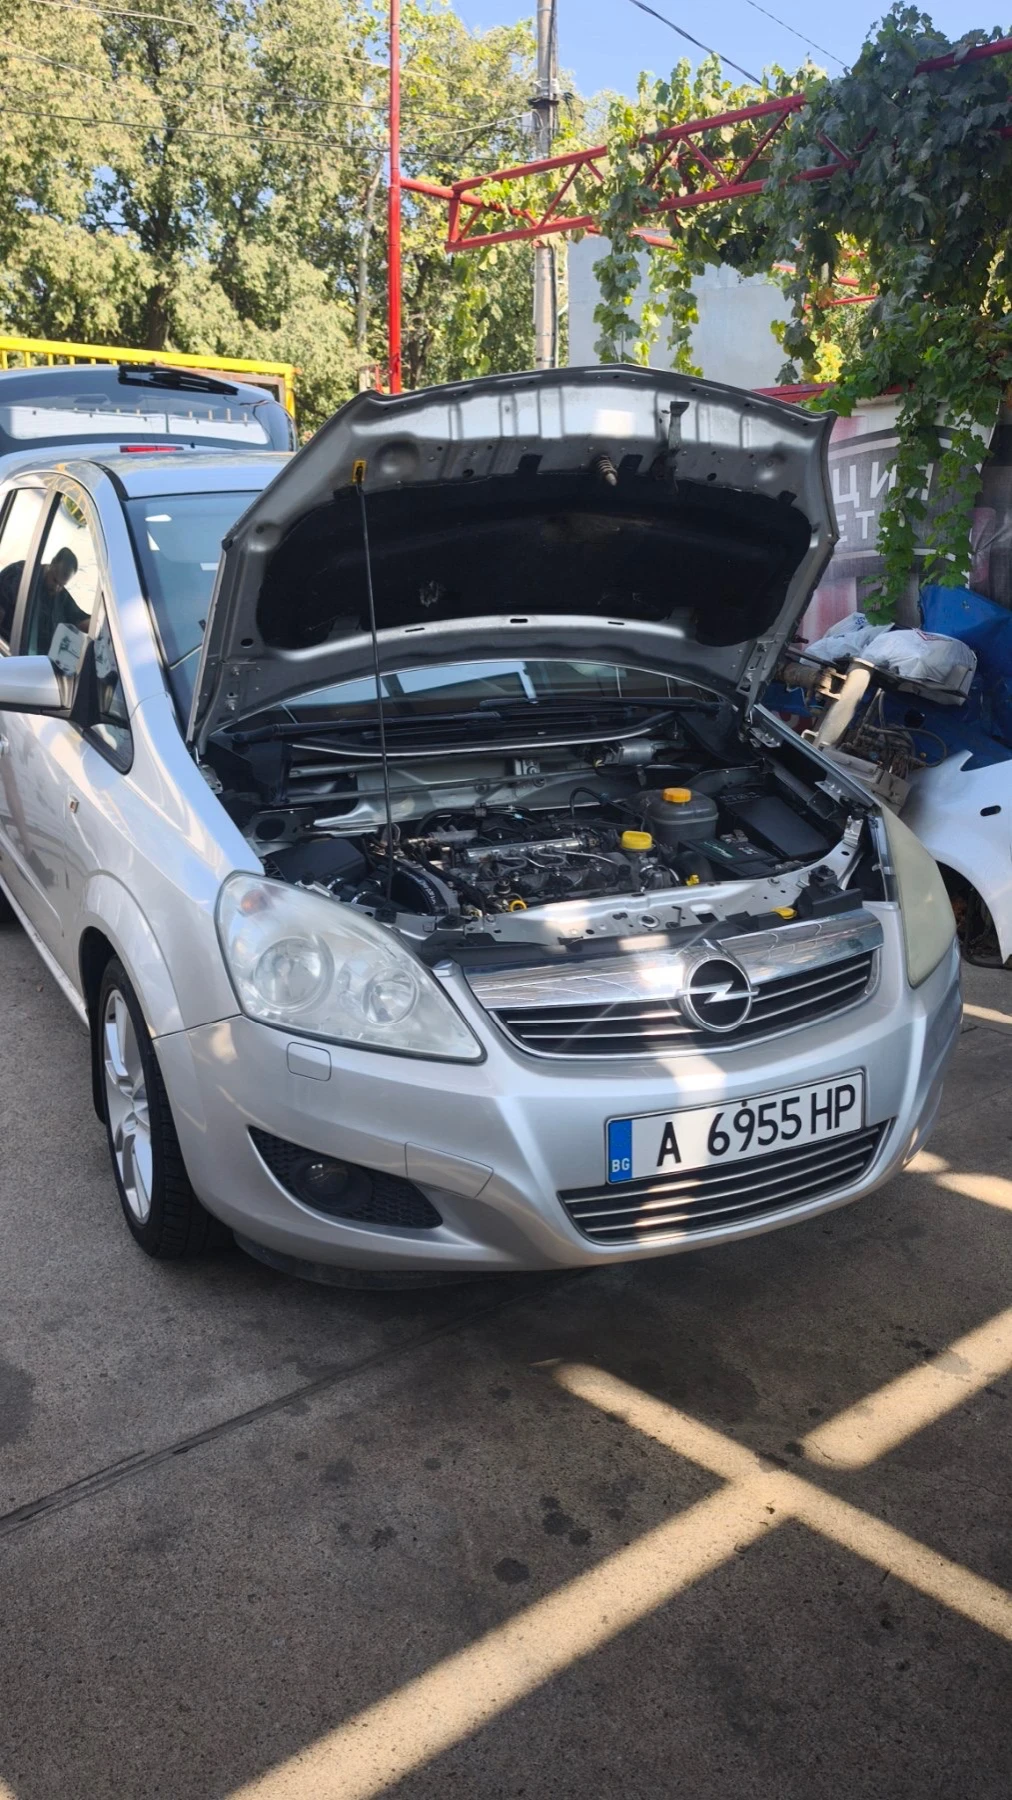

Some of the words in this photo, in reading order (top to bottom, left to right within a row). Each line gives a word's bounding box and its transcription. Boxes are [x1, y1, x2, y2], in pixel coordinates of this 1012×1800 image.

[656, 1121, 682, 1167] A
[707, 1096, 802, 1156] 6955
[811, 1084, 856, 1135] HP
[611, 1157, 630, 1173] BG
